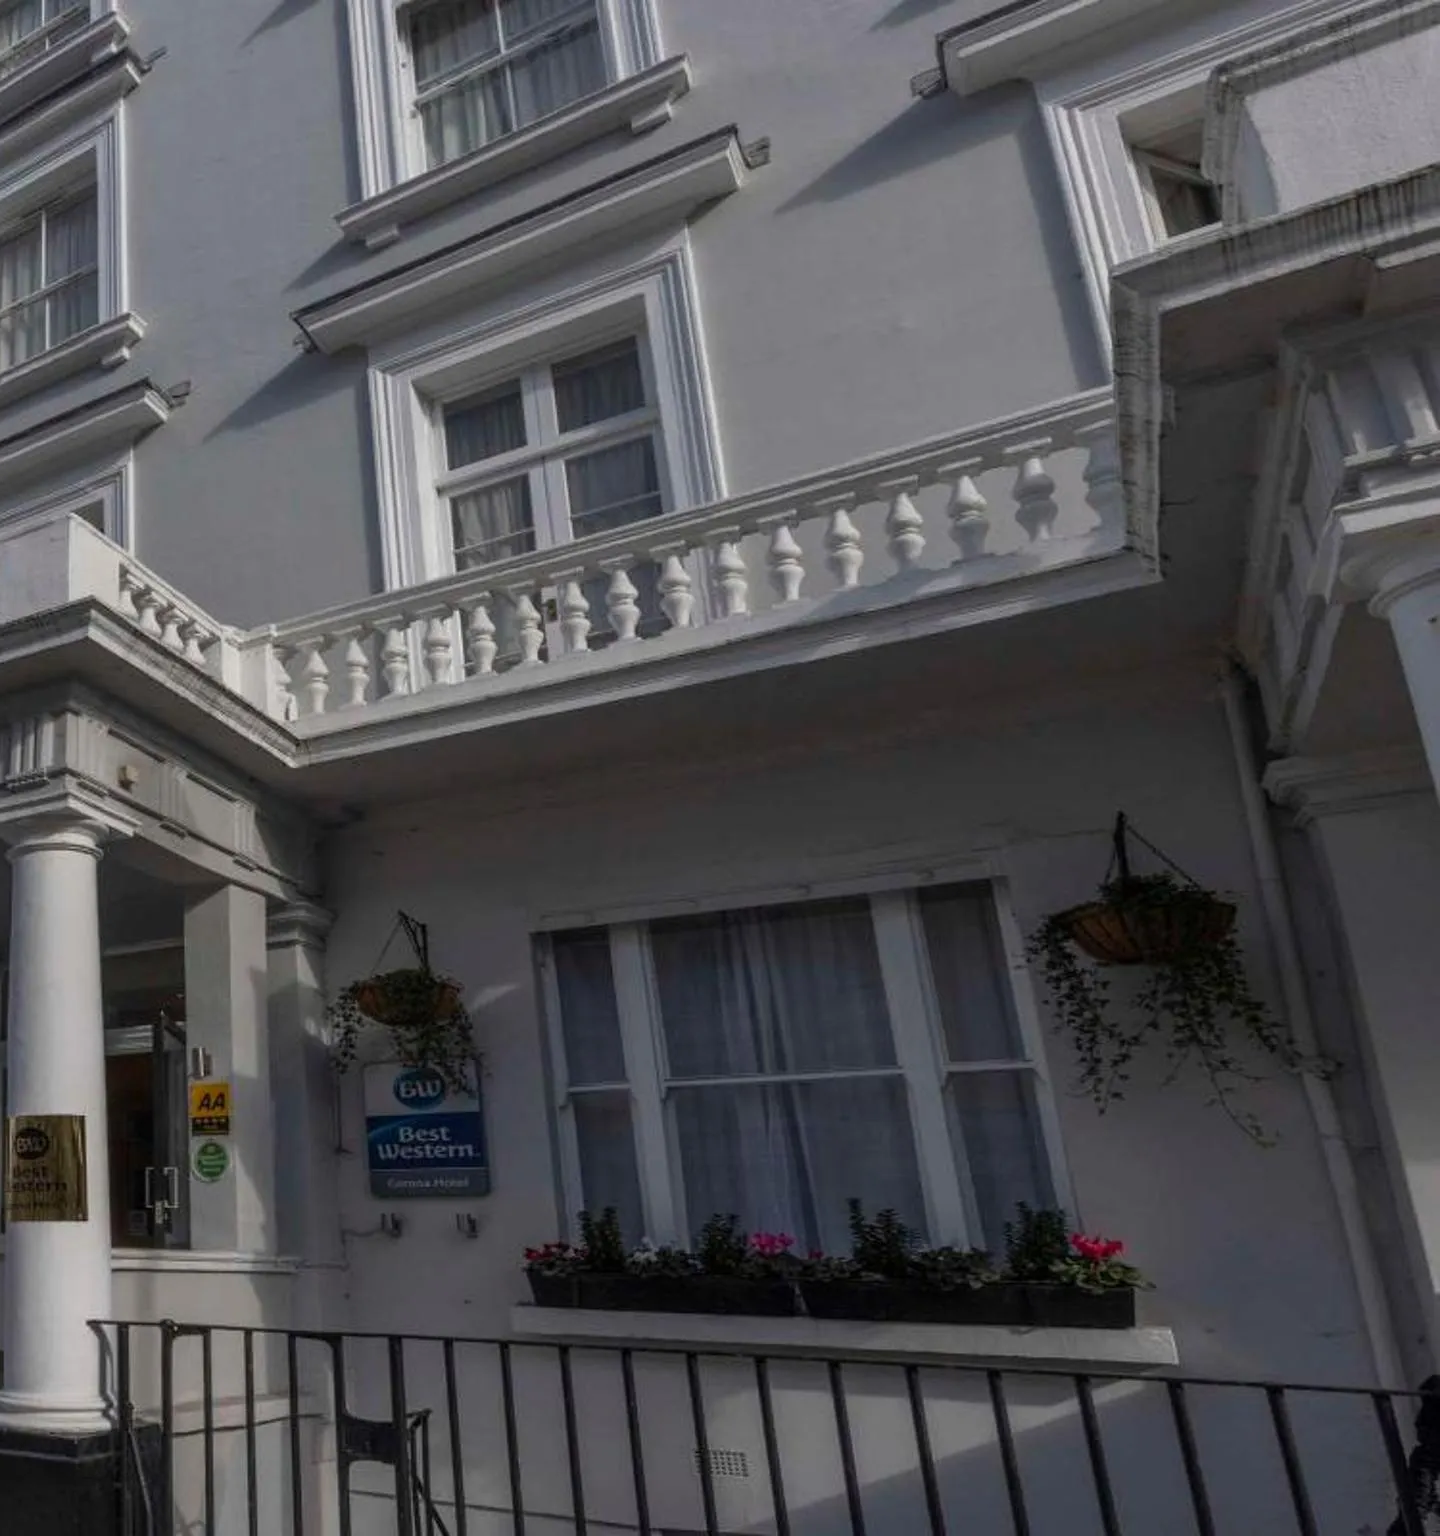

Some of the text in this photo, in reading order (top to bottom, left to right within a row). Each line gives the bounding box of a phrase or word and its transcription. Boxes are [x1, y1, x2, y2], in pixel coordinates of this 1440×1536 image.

[399, 1079, 443, 1099] BW
[197, 1091, 225, 1112] AA
[398, 1126, 452, 1143] Best
[377, 1143, 474, 1160] Western
